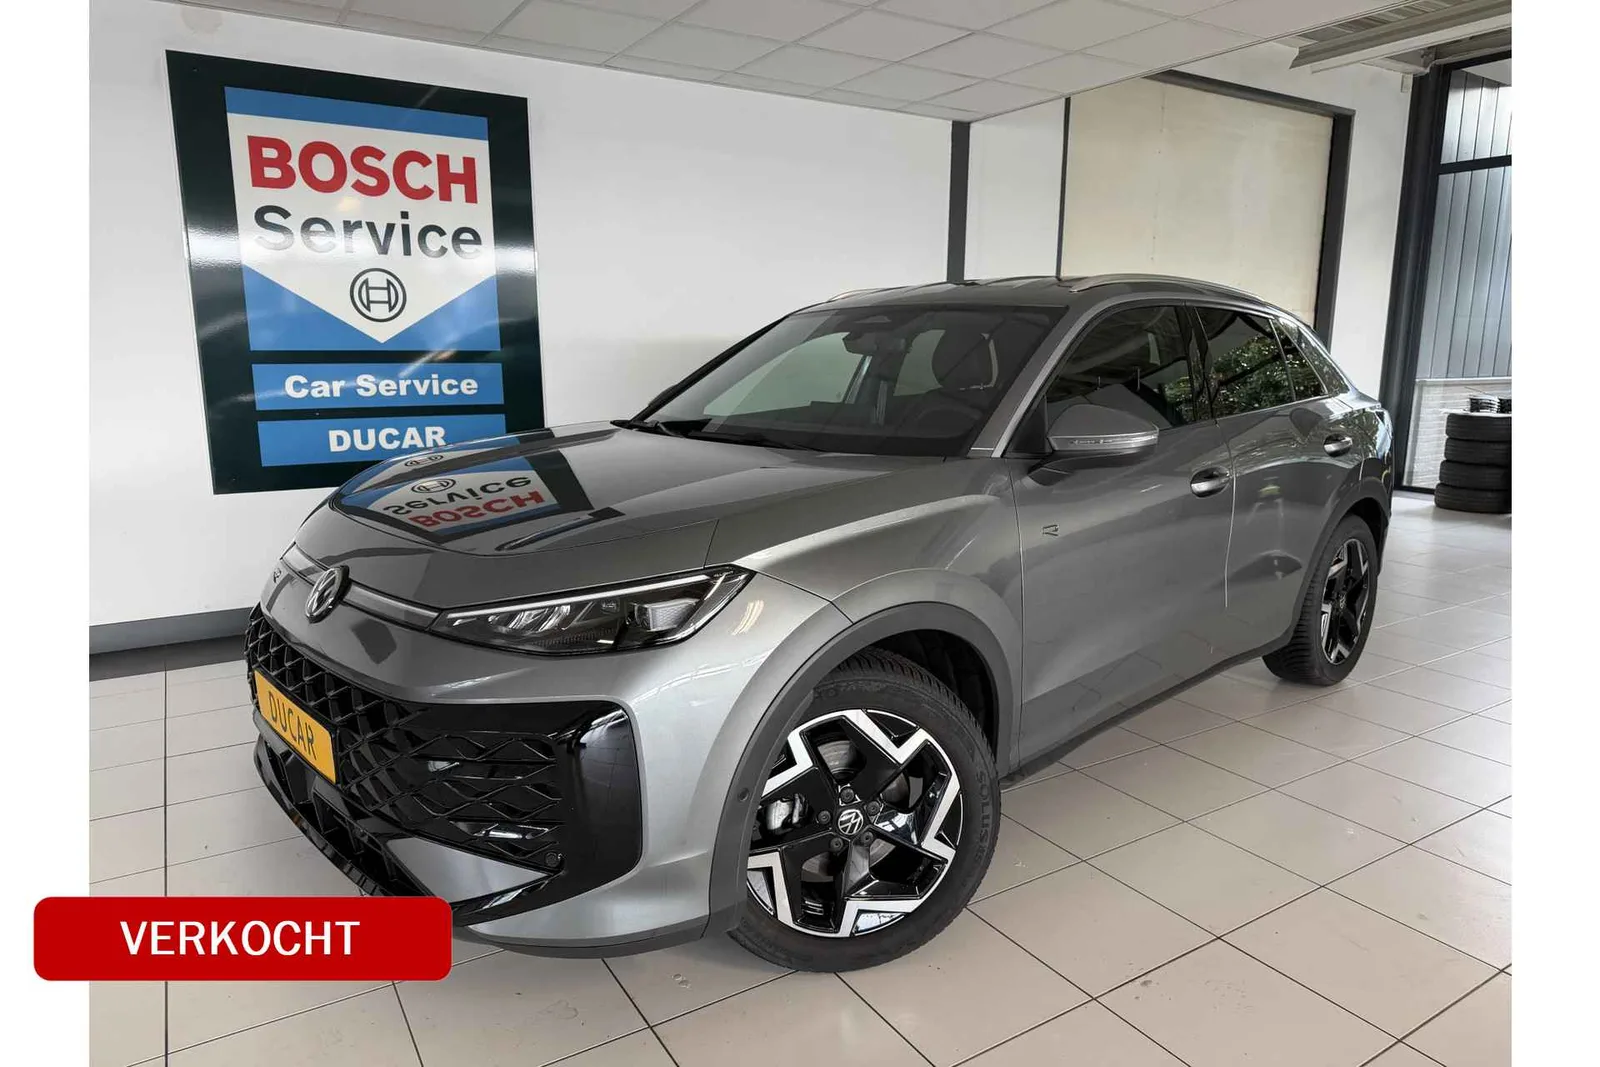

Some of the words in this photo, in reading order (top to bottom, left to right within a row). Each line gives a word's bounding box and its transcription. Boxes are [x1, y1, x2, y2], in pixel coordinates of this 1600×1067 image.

[247, 135, 479, 204] BOSCH
[253, 205, 482, 260] Service
[284, 375, 345, 398] Car
[356, 374, 479, 397] Service
[328, 426, 447, 452] DUCAR
[268, 691, 317, 761] DUCAR
